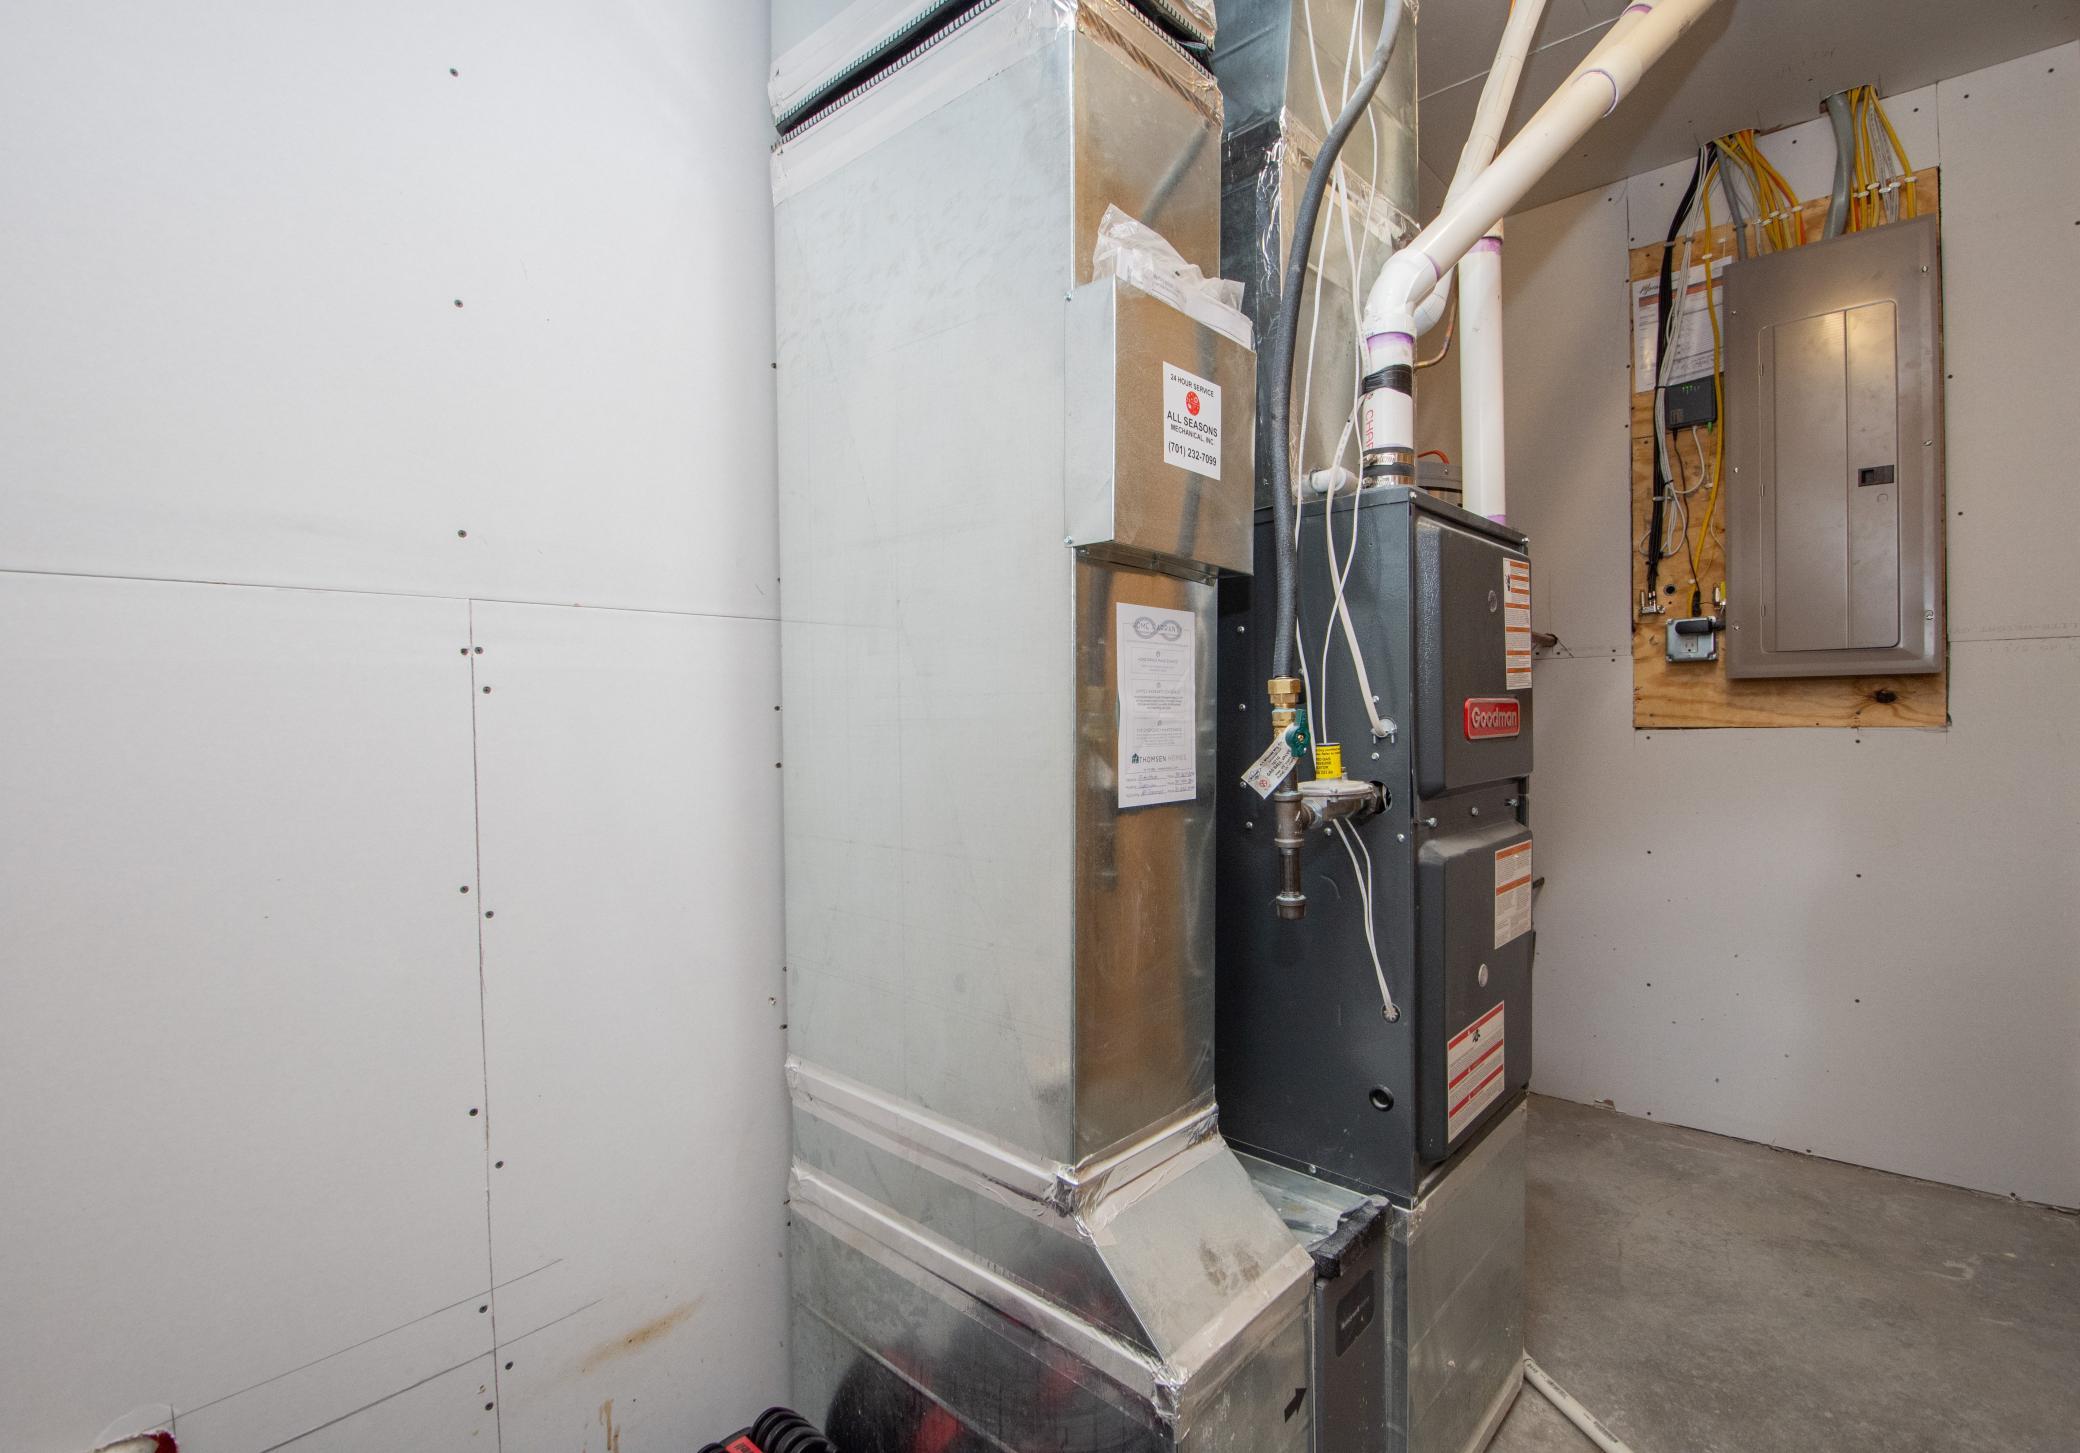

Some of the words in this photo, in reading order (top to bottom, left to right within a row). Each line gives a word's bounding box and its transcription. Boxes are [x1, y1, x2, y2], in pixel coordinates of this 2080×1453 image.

[1170, 373, 1177, 381] 24
[1177, 376, 1192, 388] HOUR
[1193, 383, 1214, 398] SERVICE
[1167, 410, 1182, 424] ALL
[1183, 417, 1218, 438] SEASONS
[1168, 441, 1186, 457] (701)
[1471, 706, 1517, 729] Goodman
[1139, 752, 1167, 763] THOMSEN
